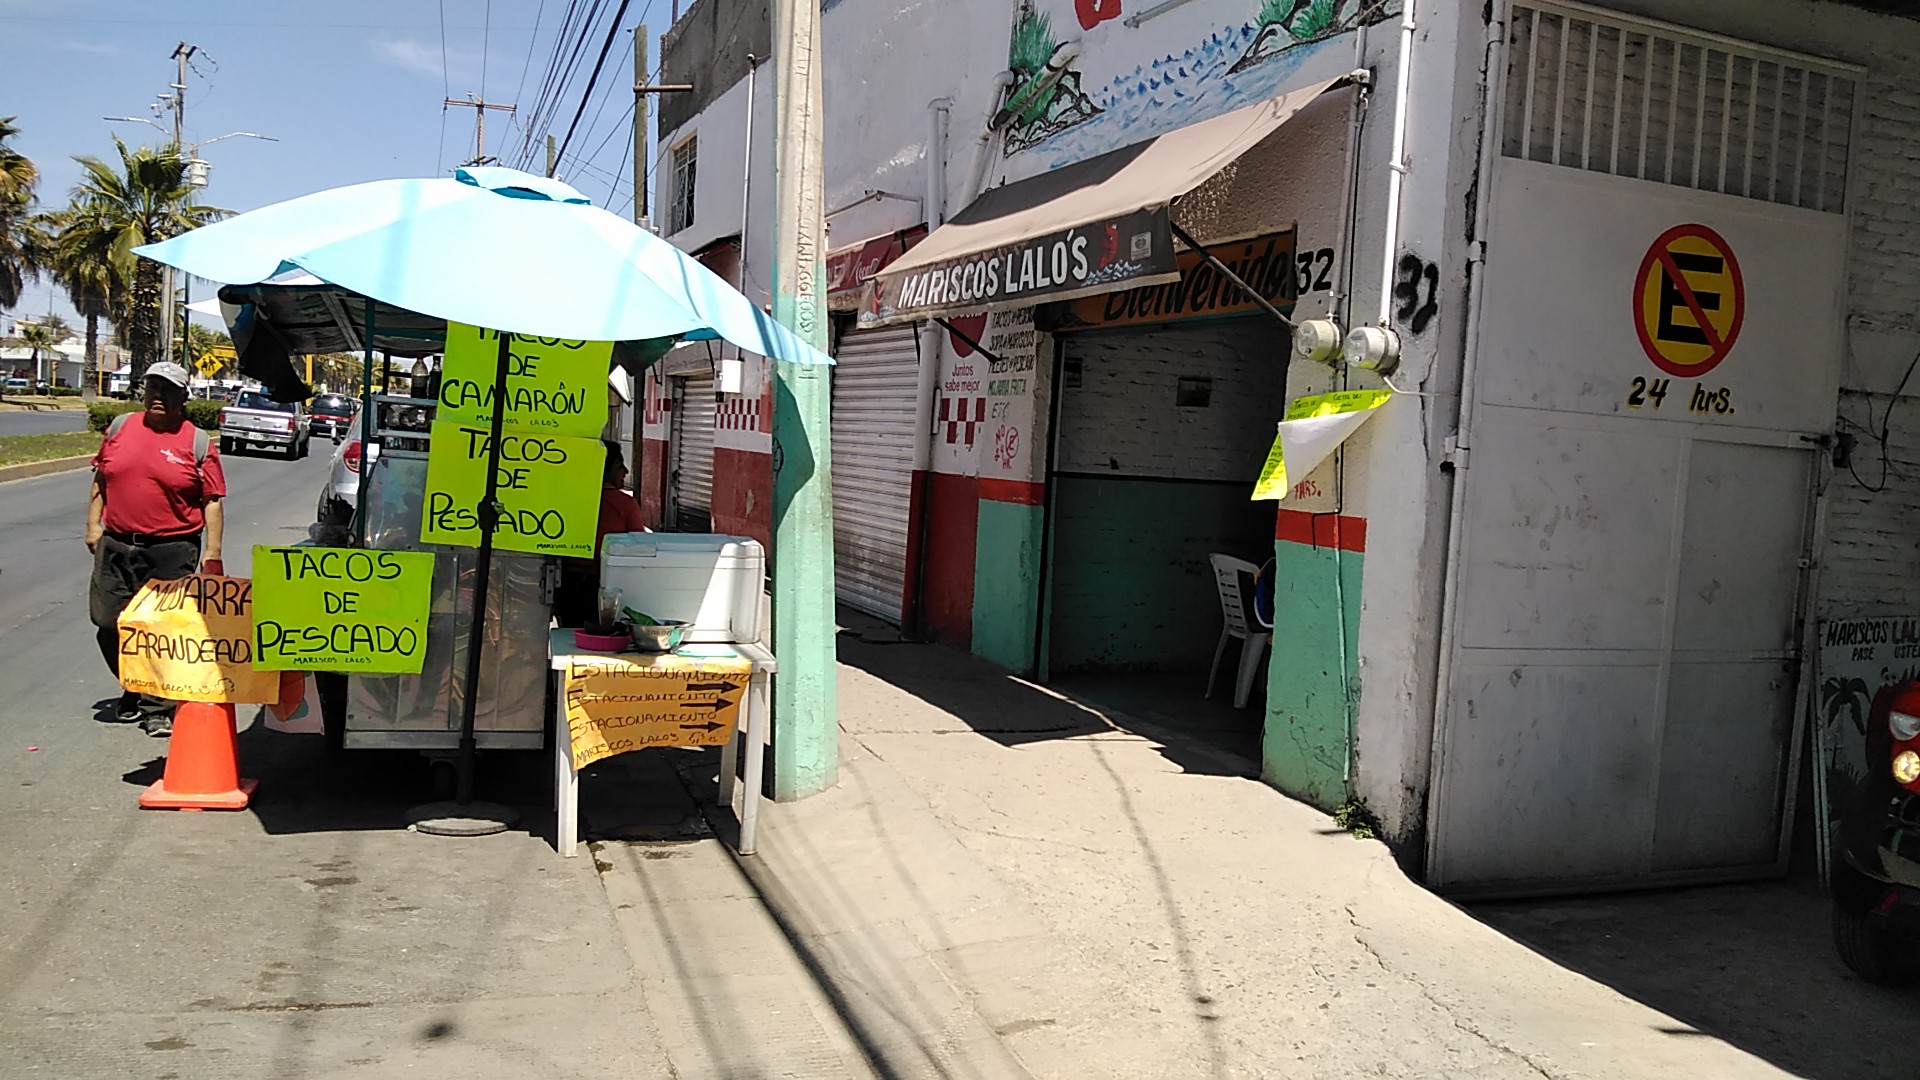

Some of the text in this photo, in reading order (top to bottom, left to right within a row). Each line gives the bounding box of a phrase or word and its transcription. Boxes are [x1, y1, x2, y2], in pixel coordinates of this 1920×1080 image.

[898, 256, 1000, 310] MARISCOS
[1297, 247, 1335, 295] 32
[506, 352, 541, 378] DE
[952, 363, 974, 377] Juntos
[945, 379, 980, 394] sabe mejor
[1628, 376, 1735, 414] 24 hrs.
[496, 467, 531, 489] DE
[428, 491, 565, 540] PESADO
[270, 549, 402, 582] TACOS
[323, 591, 360, 614] DE
[119, 626, 252, 664] ZARANDEAD
[256, 620, 417, 662] PESCADO
[1825, 619, 1889, 646] MARISCOS
[293, 656, 338, 665] MARISCOS
[1852, 646, 1875, 661] PASE
[571, 655, 751, 683] ESTACIONAMIENTO
[567, 689, 720, 711] ESTACIONAMIENTO
[567, 711, 718, 739] ESTACIONAMIENTO
[576, 738, 634, 767] MARISCOS
